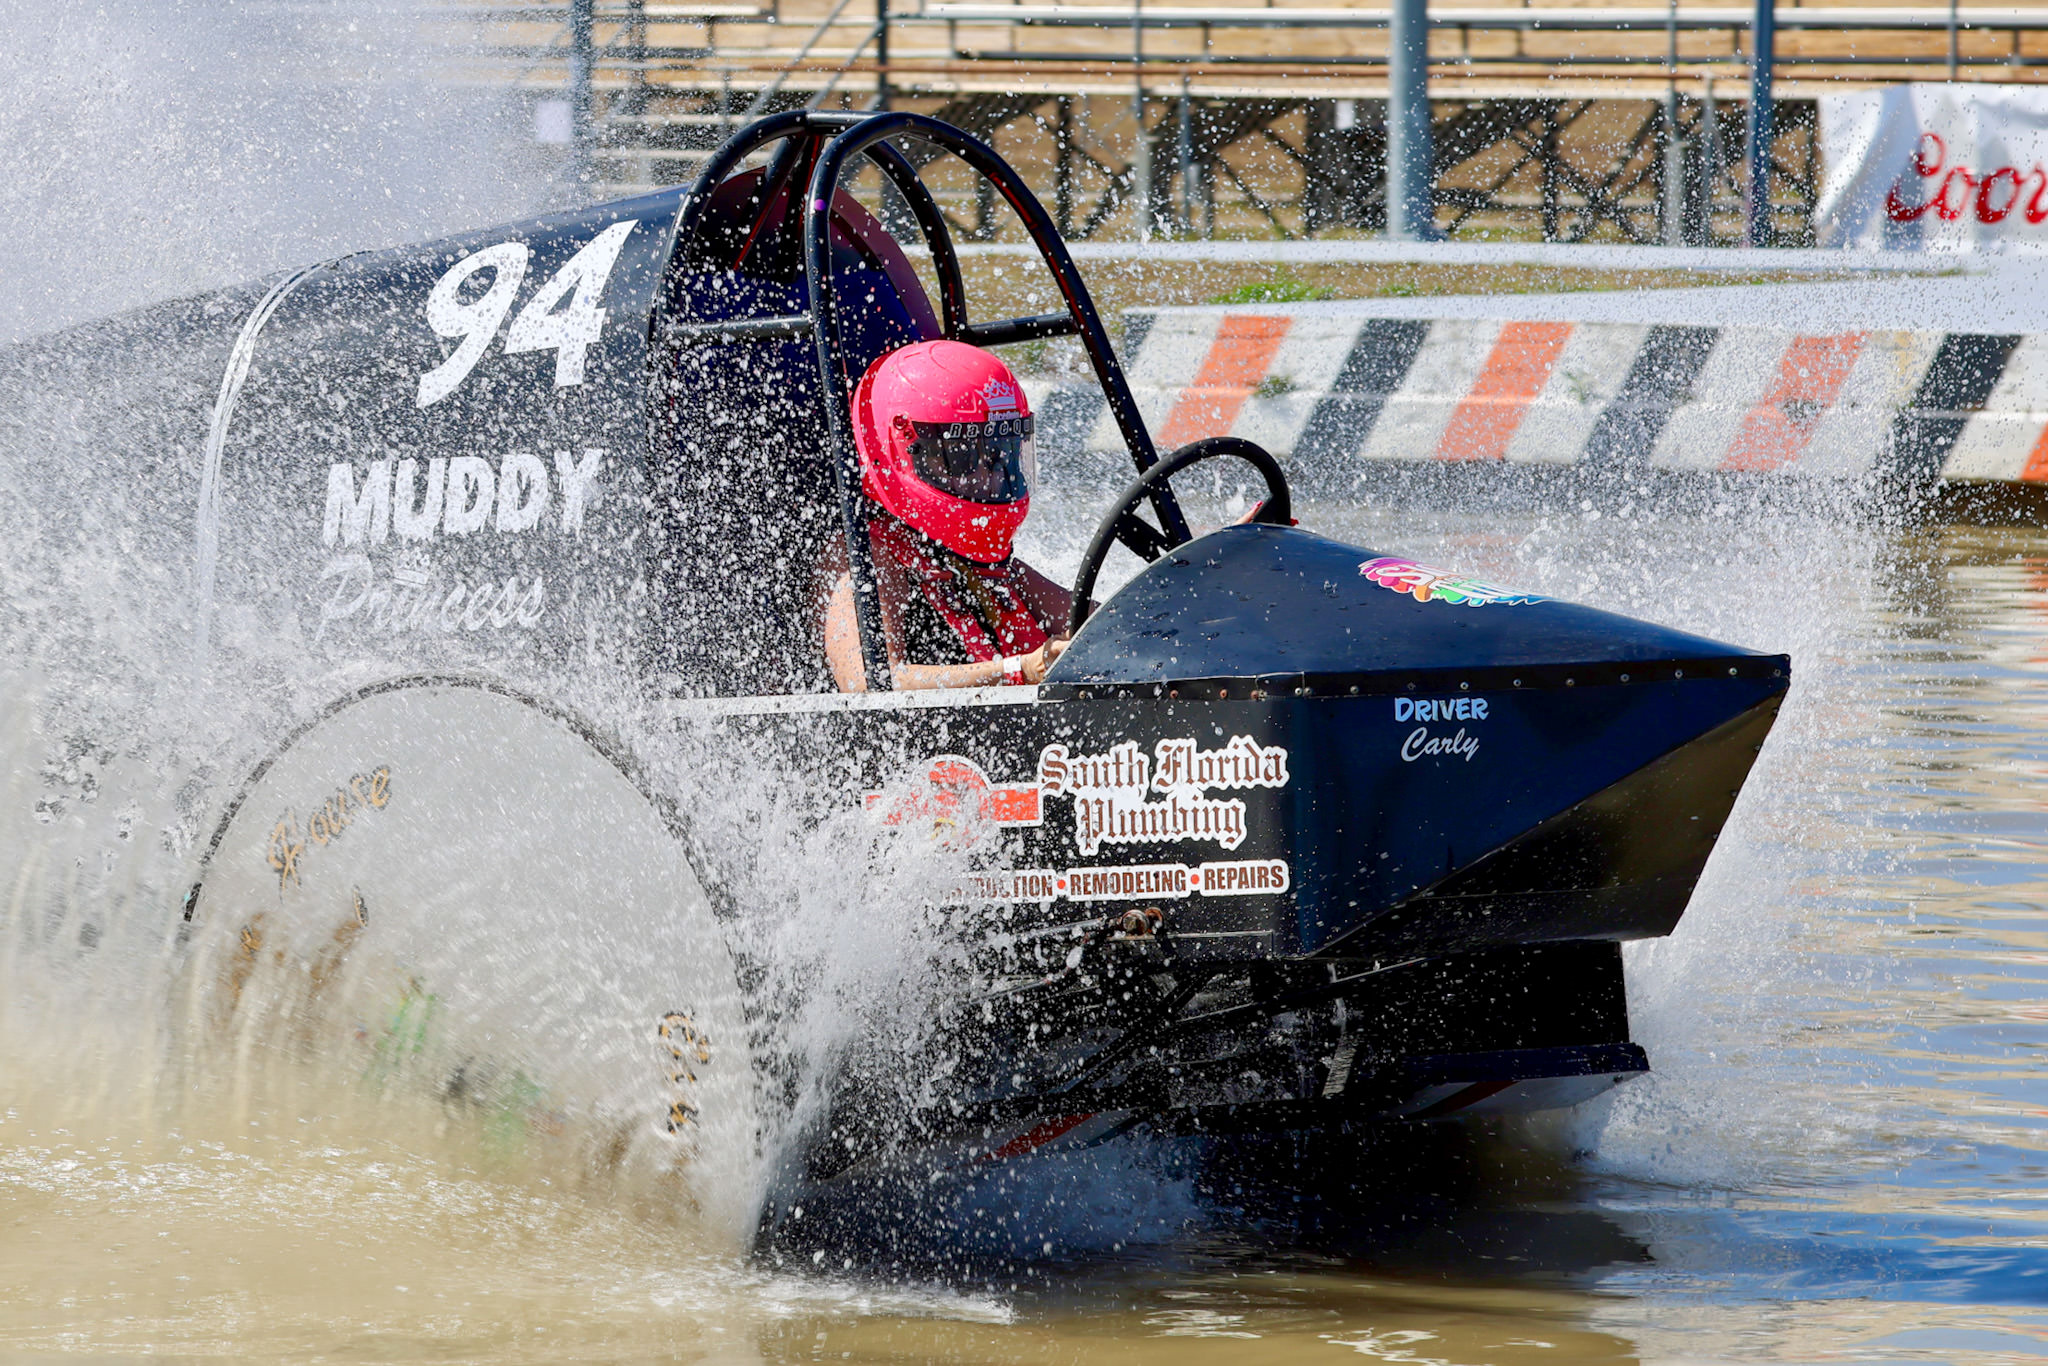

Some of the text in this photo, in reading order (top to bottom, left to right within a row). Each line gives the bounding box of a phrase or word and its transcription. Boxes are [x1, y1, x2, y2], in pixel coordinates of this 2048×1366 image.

[416, 219, 638, 409] 94
[322, 449, 604, 549] MUDDY
[1394, 697, 1489, 722] DRIVER
[1039, 738, 1286, 796] South Florida
[1401, 726, 1480, 762] Carly
[1078, 793, 1246, 850] Plumbing
[1069, 868, 1188, 897] REMODELING
[1203, 864, 1286, 890] REPAIRS
